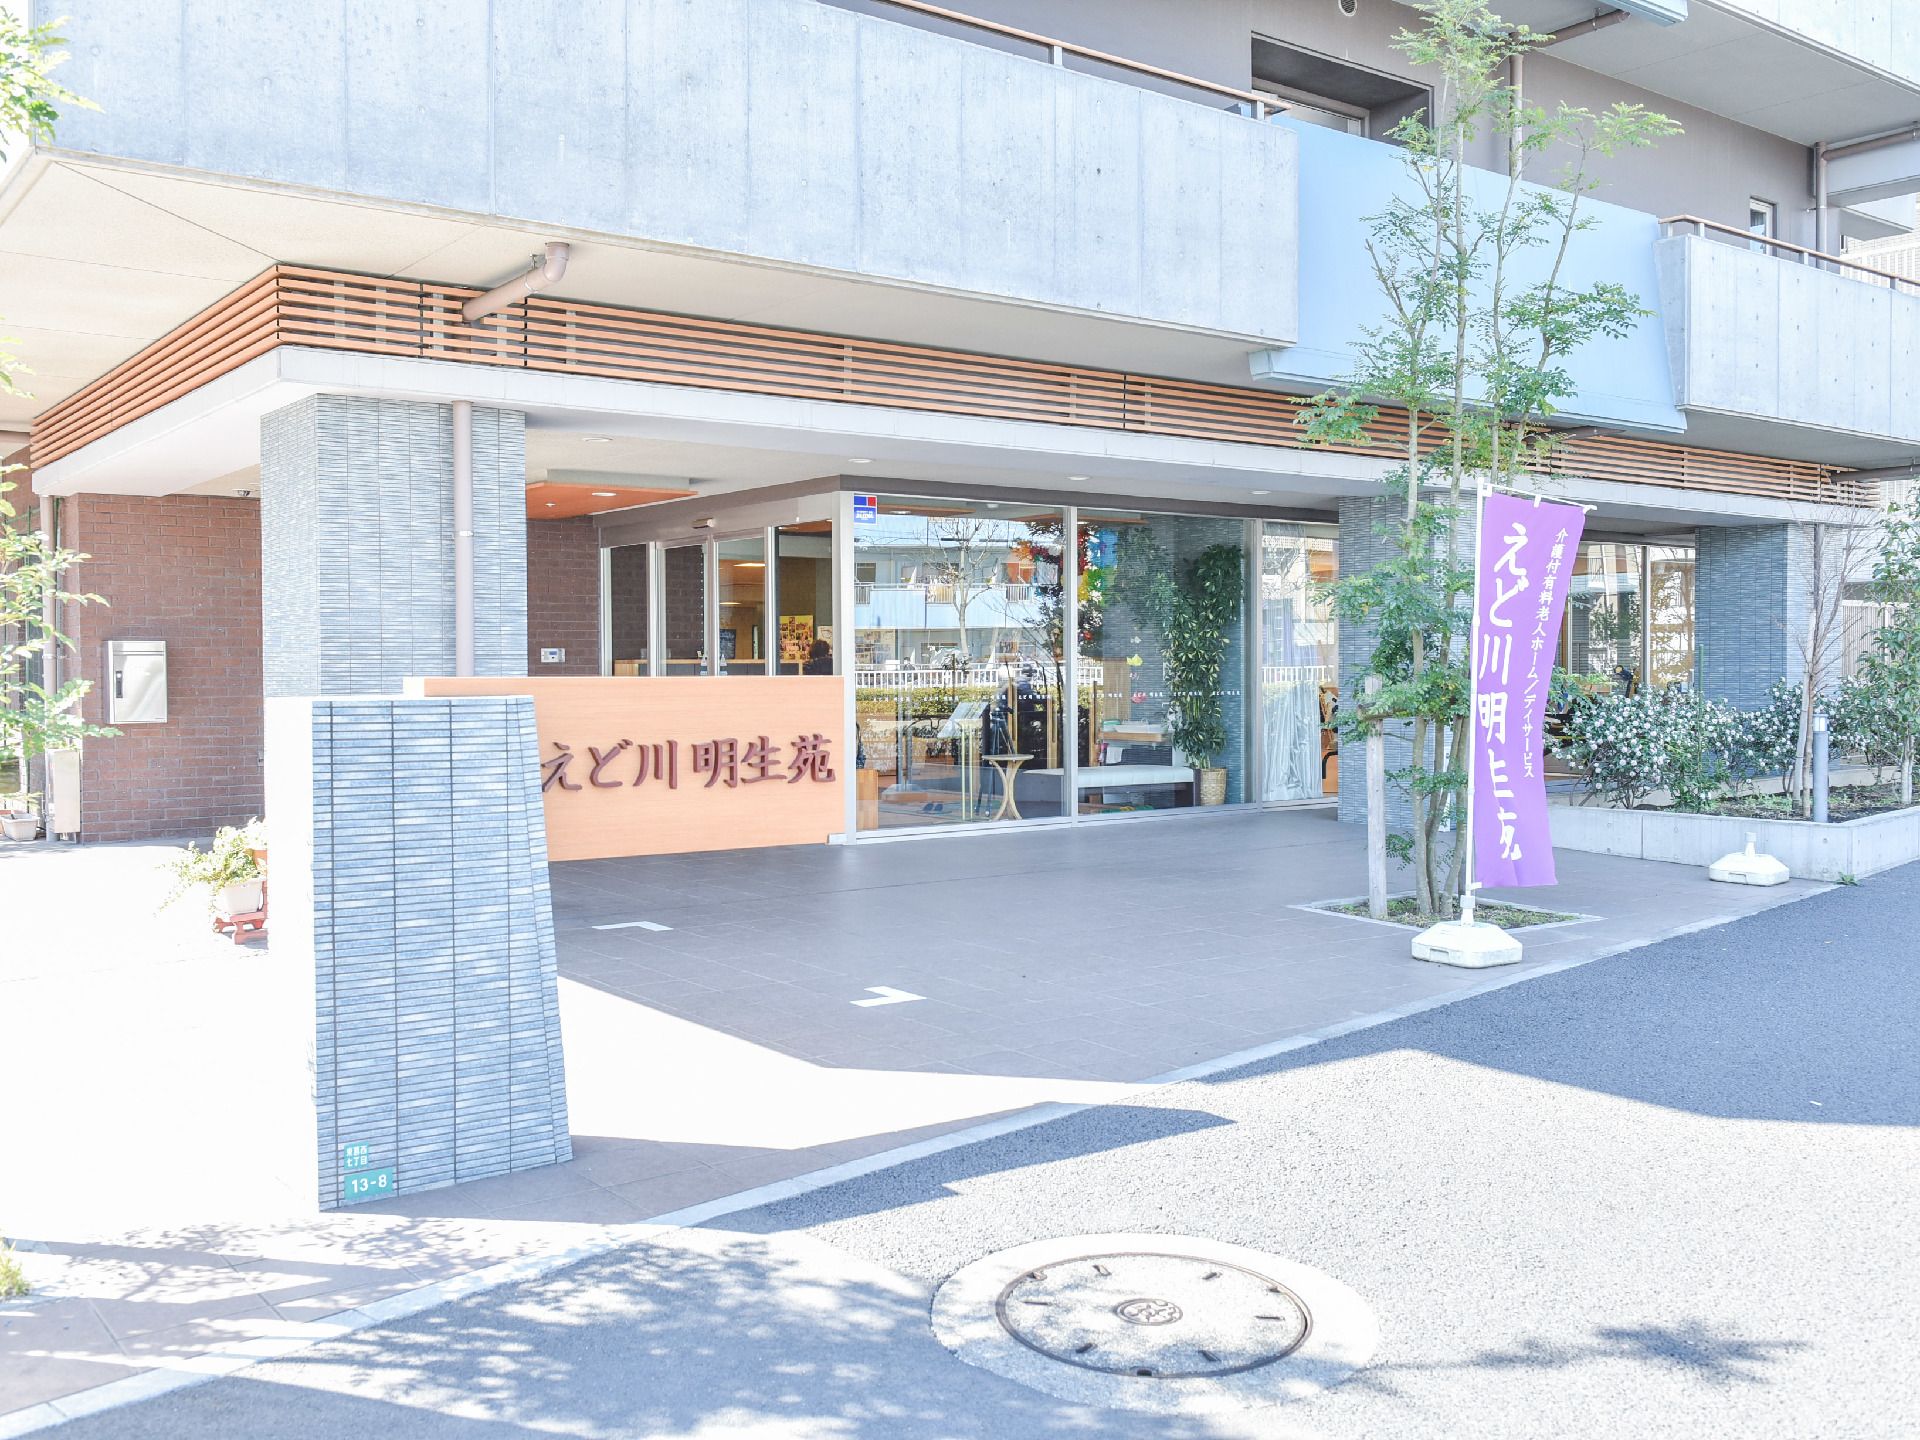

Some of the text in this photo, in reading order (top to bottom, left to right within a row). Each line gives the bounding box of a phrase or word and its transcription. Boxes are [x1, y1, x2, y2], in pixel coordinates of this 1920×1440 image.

[541, 733, 836, 793] えど川明生苑
[351, 1174, 387, 1193] 13-8
